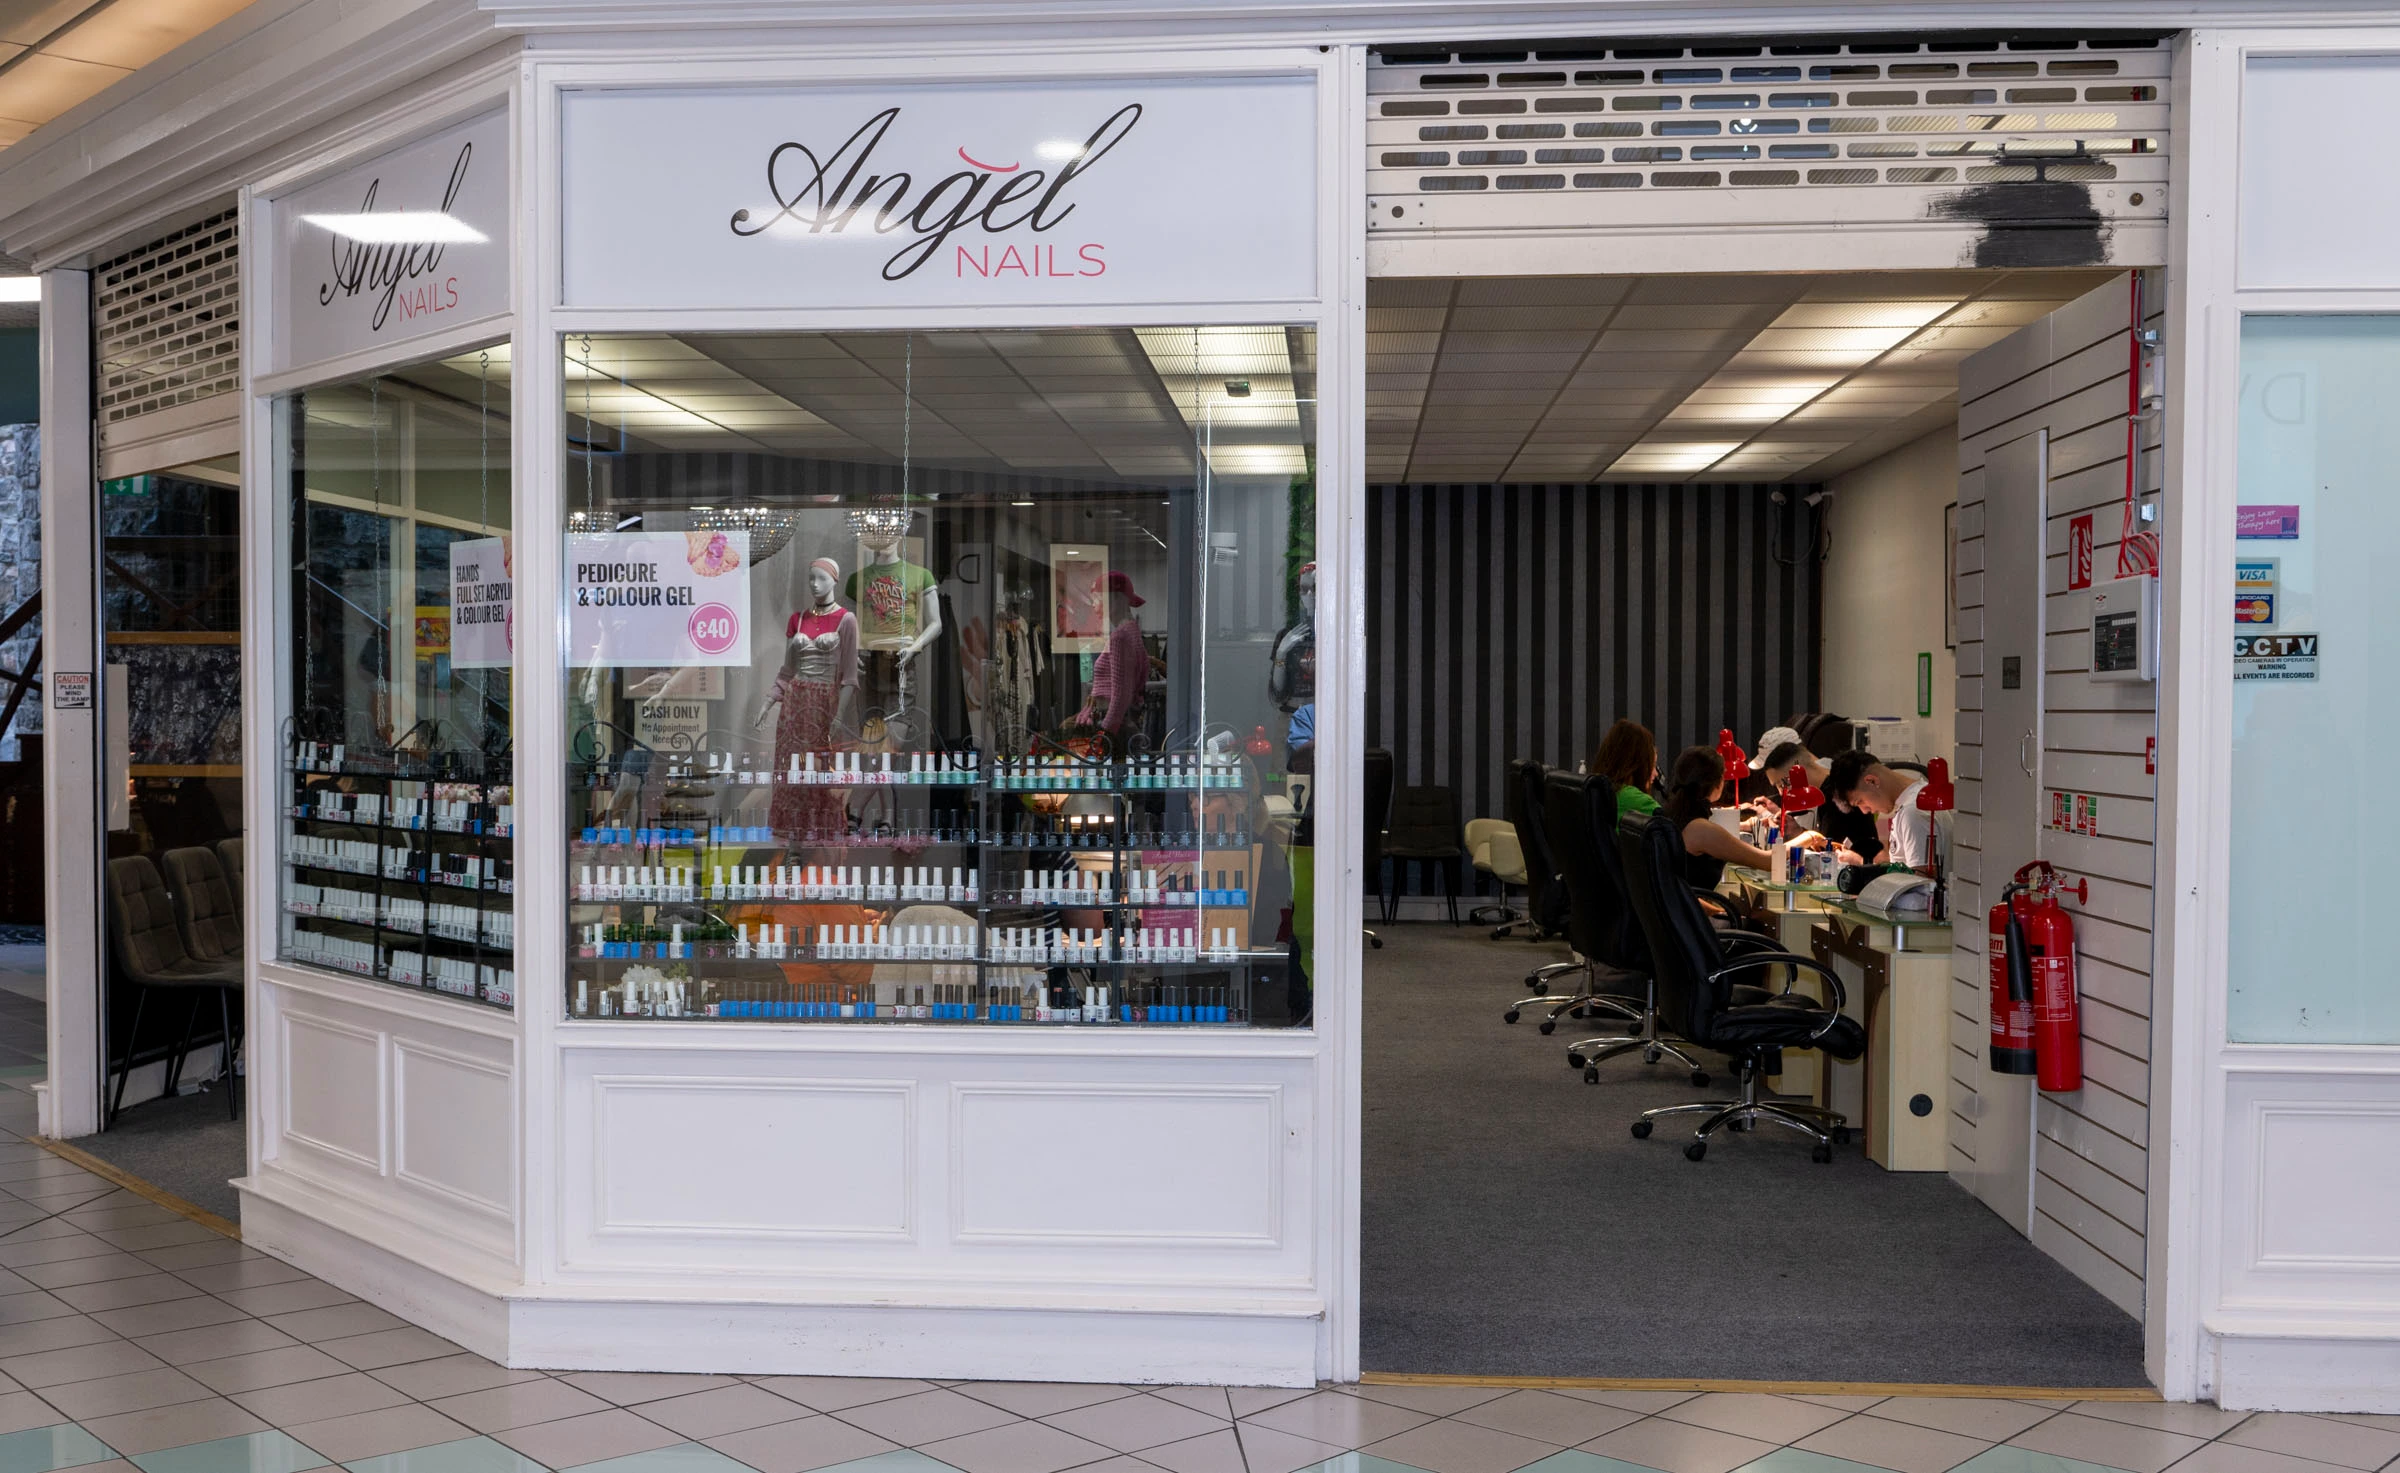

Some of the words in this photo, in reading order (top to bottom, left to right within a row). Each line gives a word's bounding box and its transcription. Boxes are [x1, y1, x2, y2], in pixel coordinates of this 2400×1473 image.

[730, 103, 1143, 281] Angel
[956, 243, 1106, 278] NAILS
[399, 277, 458, 322] NAILS
[456, 564, 479, 583] HANDS
[577, 563, 658, 583] PEDICURE
[2239, 570, 2267, 580] VISA
[456, 586, 473, 604] FULL
[473, 584, 485, 602] SET
[486, 582, 513, 601] ACRYLI
[578, 586, 590, 607] &
[594, 586, 662, 607] COLOUR
[666, 586, 696, 606] GEL
[456, 607, 463, 625] &
[463, 605, 491, 624] COLOUR
[492, 604, 505, 623] GEL
[696, 618, 730, 639] €40
[642, 705, 671, 719] CASH
[673, 705, 700, 719] ONLY
[642, 723, 652, 732] No
[653, 722, 700, 734] Appointment
